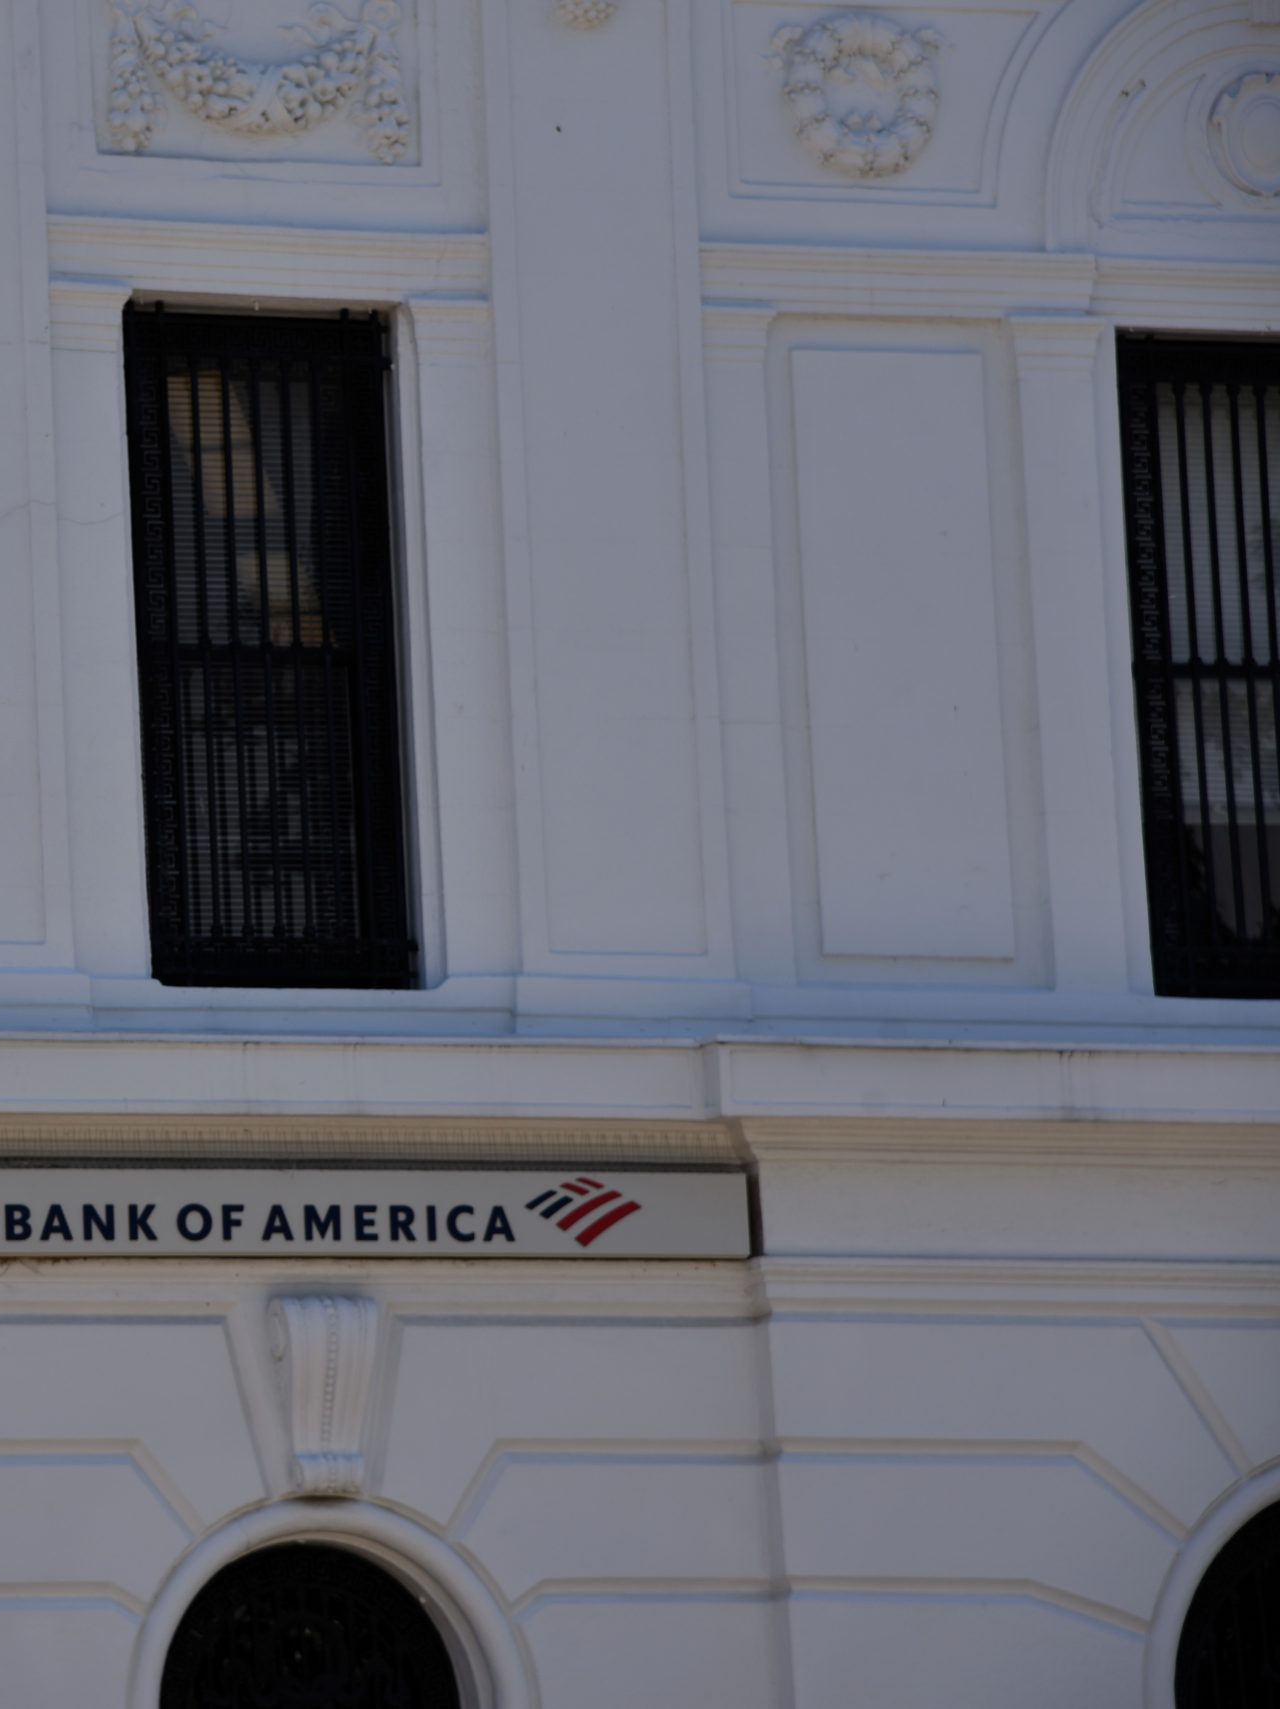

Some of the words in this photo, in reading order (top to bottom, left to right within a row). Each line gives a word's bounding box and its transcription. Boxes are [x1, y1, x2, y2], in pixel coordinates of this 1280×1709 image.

[4, 1203, 158, 1242] BANK
[176, 1203, 245, 1242] OF
[261, 1204, 516, 1243] AMERICA
